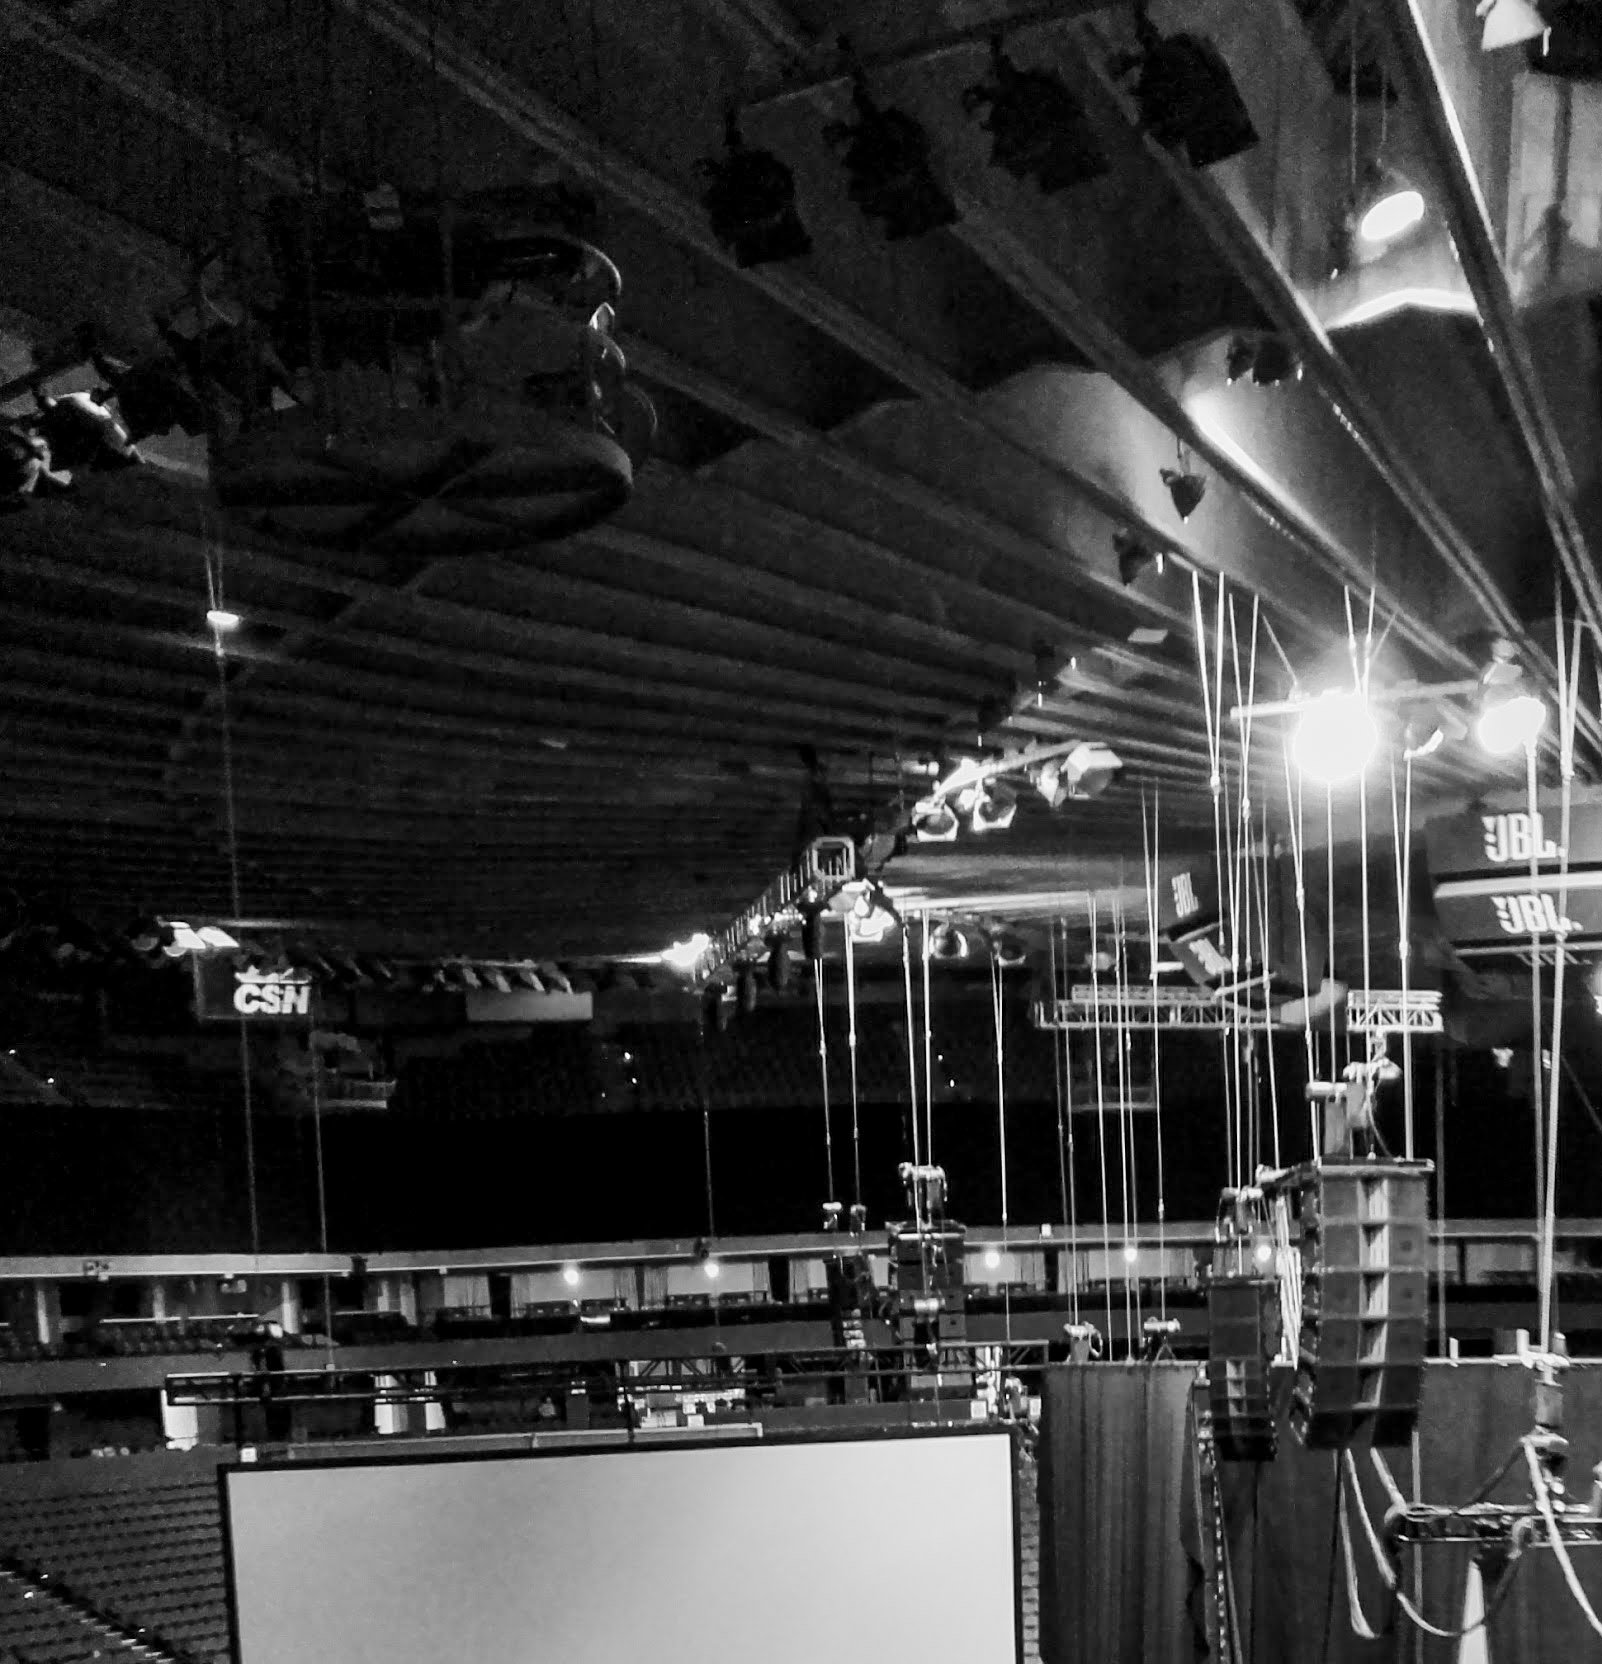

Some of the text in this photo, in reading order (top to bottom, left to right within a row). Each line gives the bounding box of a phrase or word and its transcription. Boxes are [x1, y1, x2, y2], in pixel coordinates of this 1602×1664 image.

[1482, 811, 1557, 862] JBL
[1491, 893, 1573, 934] JBL
[233, 983, 311, 1015] CSN
